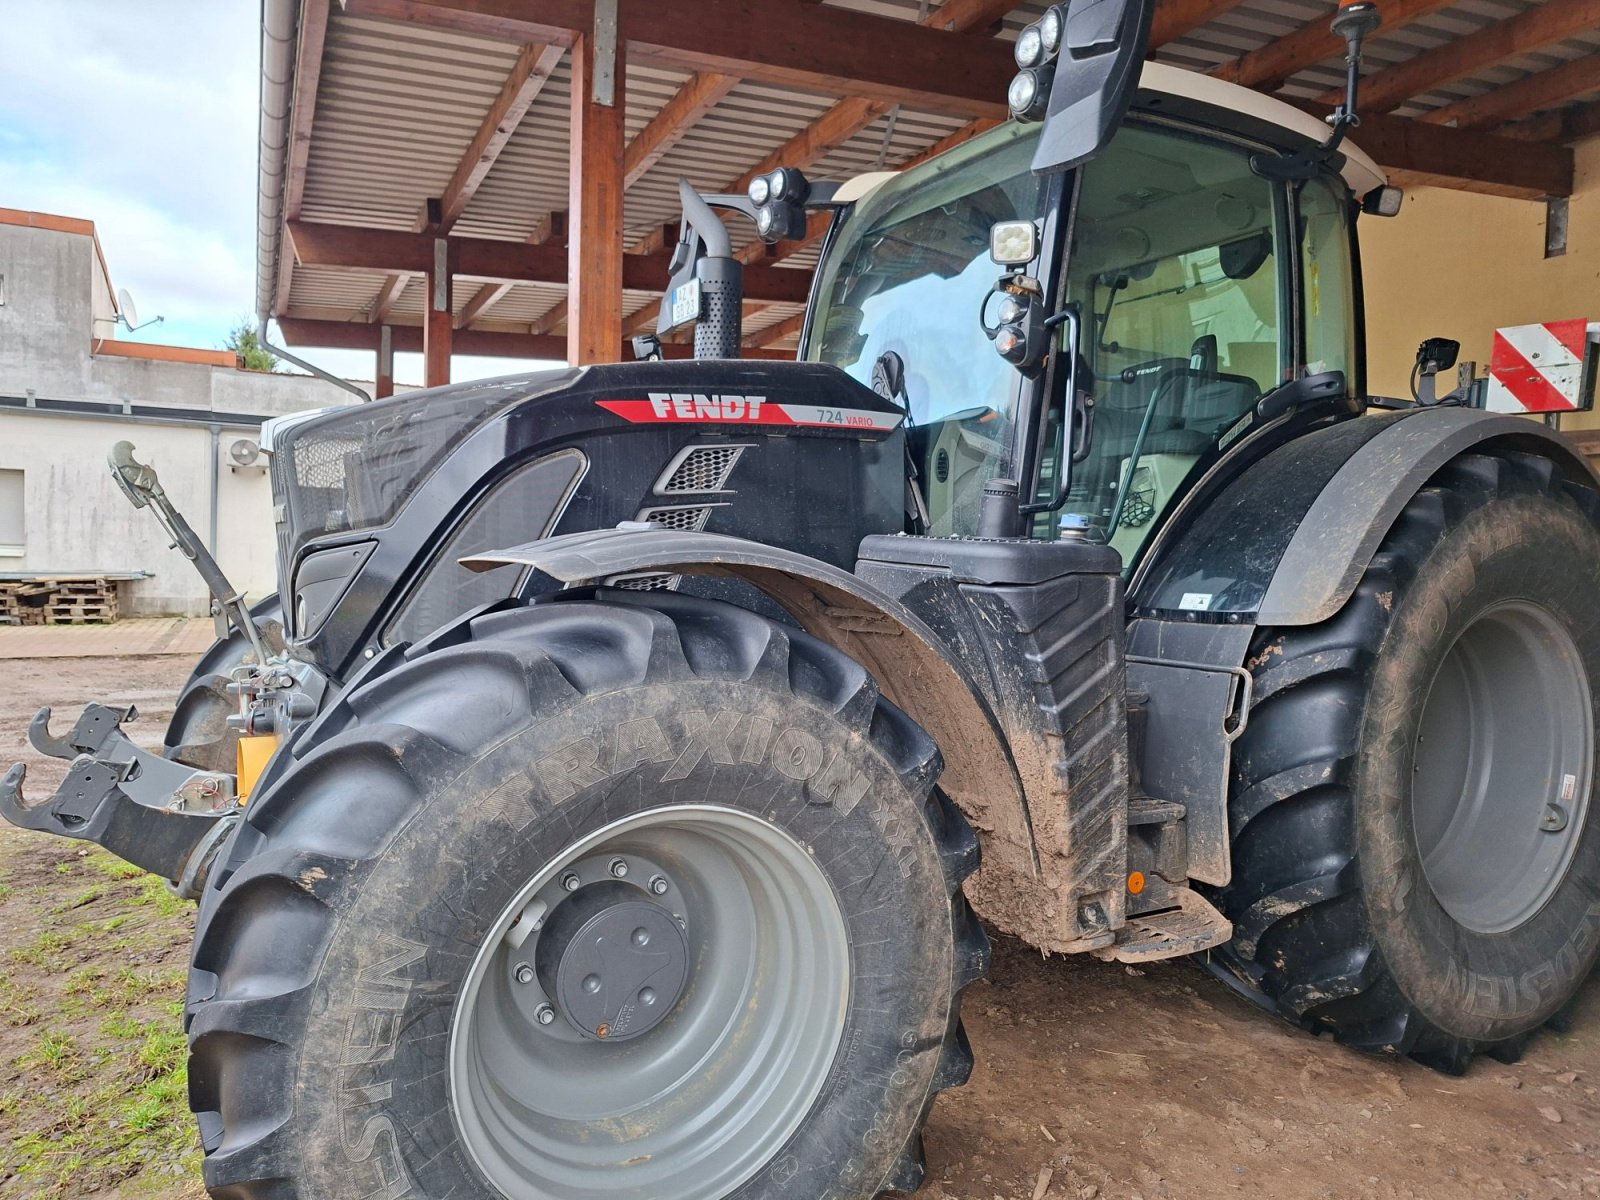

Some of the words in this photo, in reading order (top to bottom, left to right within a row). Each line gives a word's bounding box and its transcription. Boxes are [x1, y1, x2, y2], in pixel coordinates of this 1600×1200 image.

[648, 393, 767, 419] FENDT
[816, 409, 843, 424] 724
[845, 415, 874, 427] VARIO
[478, 709, 872, 833] TRAXION
